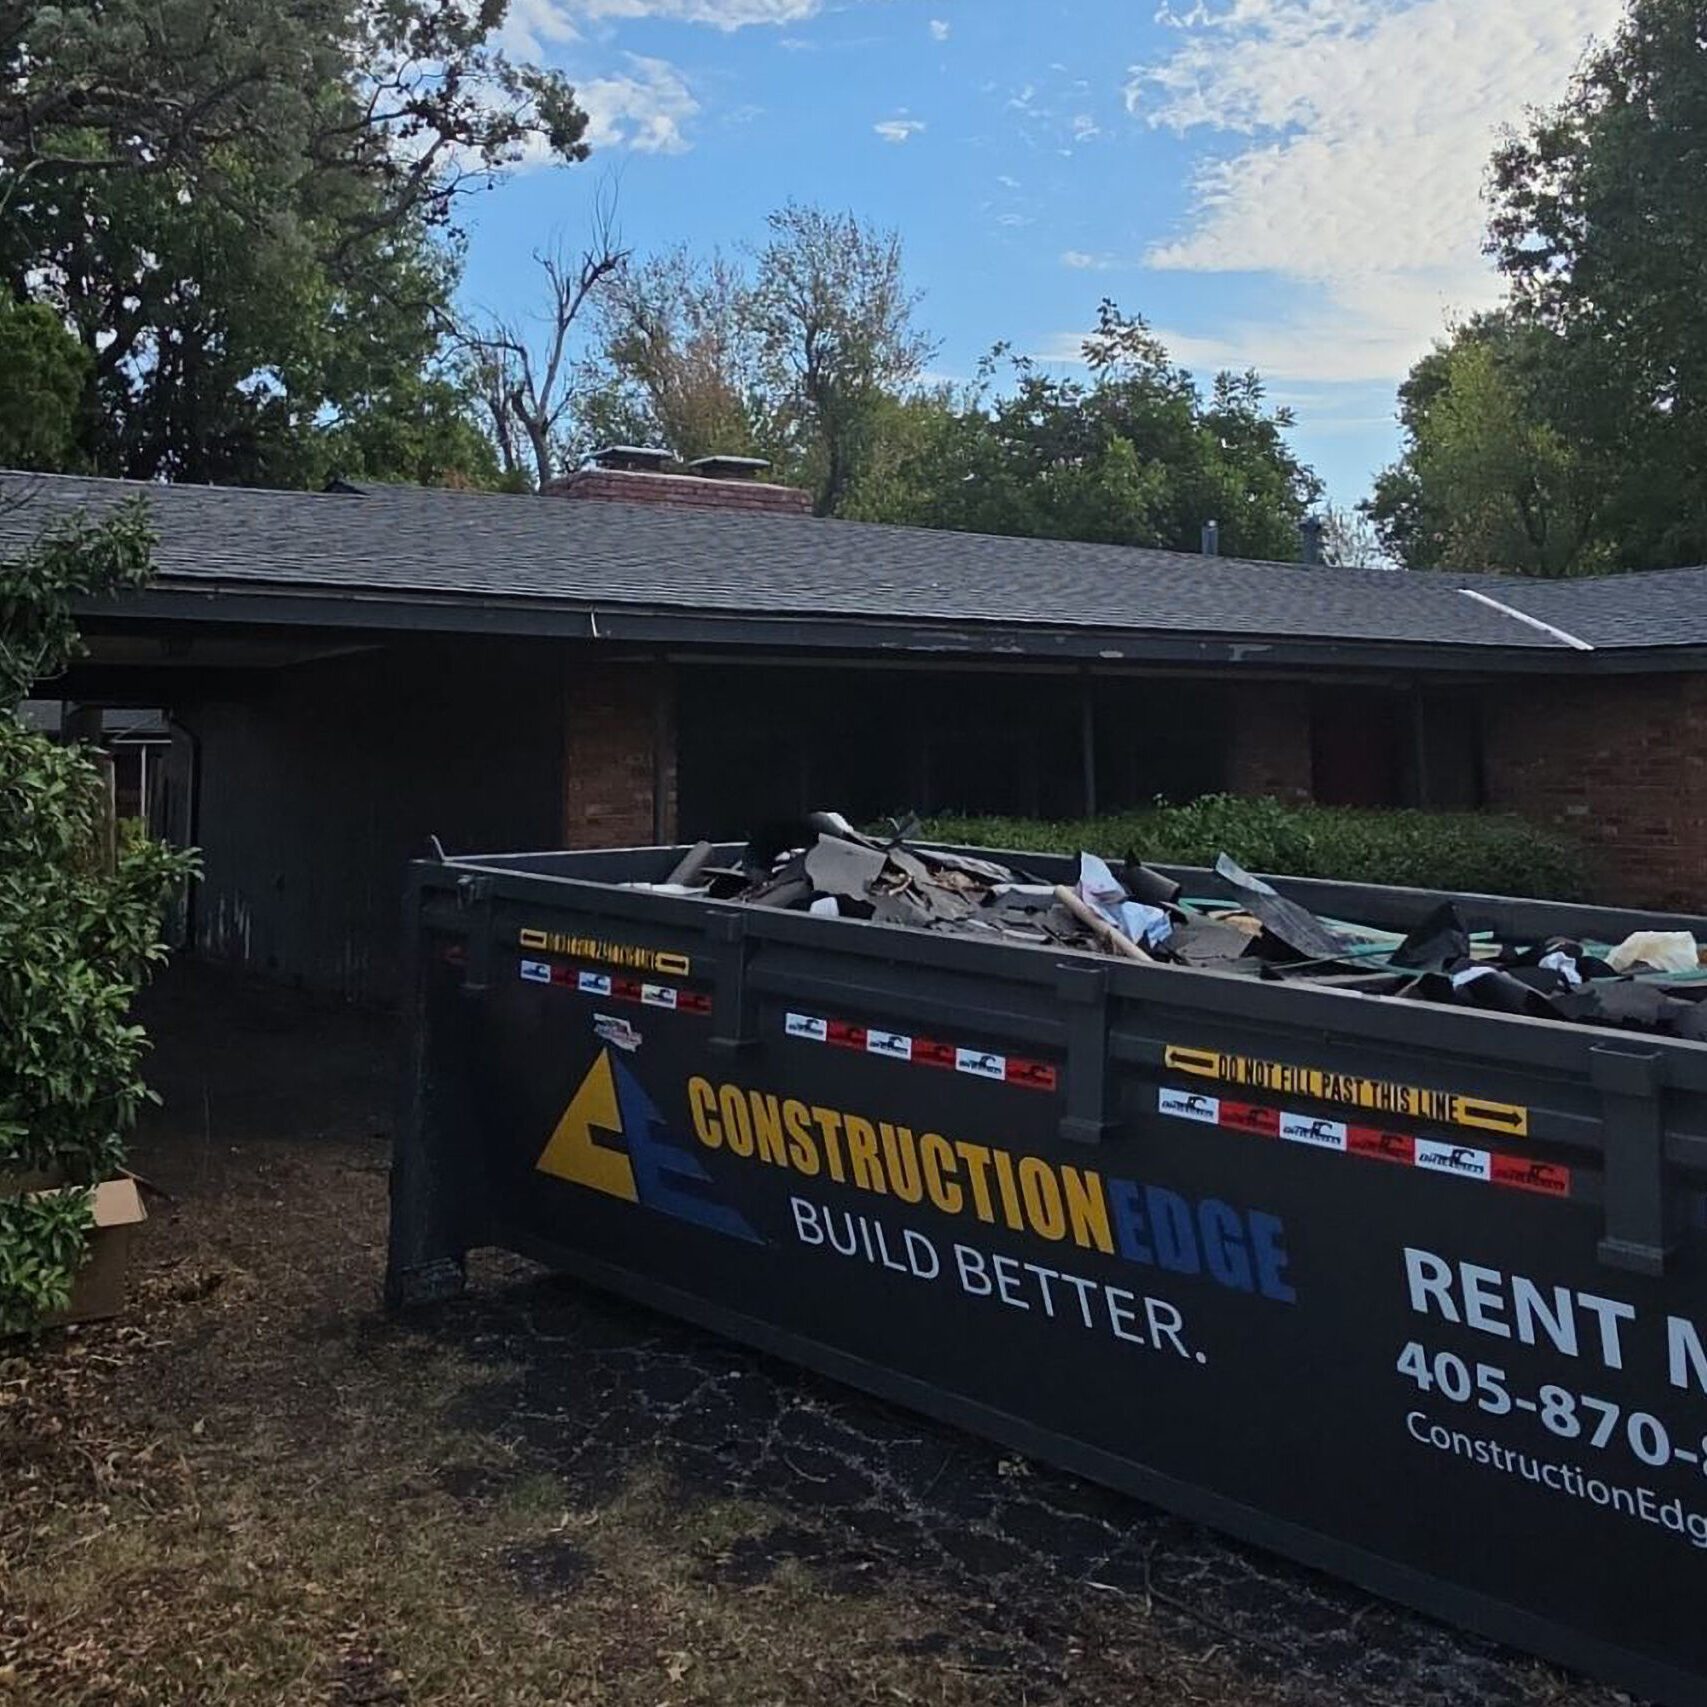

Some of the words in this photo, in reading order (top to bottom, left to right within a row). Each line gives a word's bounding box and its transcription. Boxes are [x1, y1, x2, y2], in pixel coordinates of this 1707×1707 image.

[1218, 1056, 1238, 1079] DO
[1244, 1059, 1275, 1088] NOT
[1281, 1066, 1316, 1095] FILL
[1322, 1073, 1365, 1104] PAST
[1370, 1082, 1410, 1114] THIS
[1417, 1089, 1459, 1121] LINE
[790, 1197, 940, 1279] BUILD
[954, 1243, 1207, 1364] BETTER.
[1404, 1247, 1636, 1370] RENT
[1396, 1341, 1707, 1477] 405-870-
